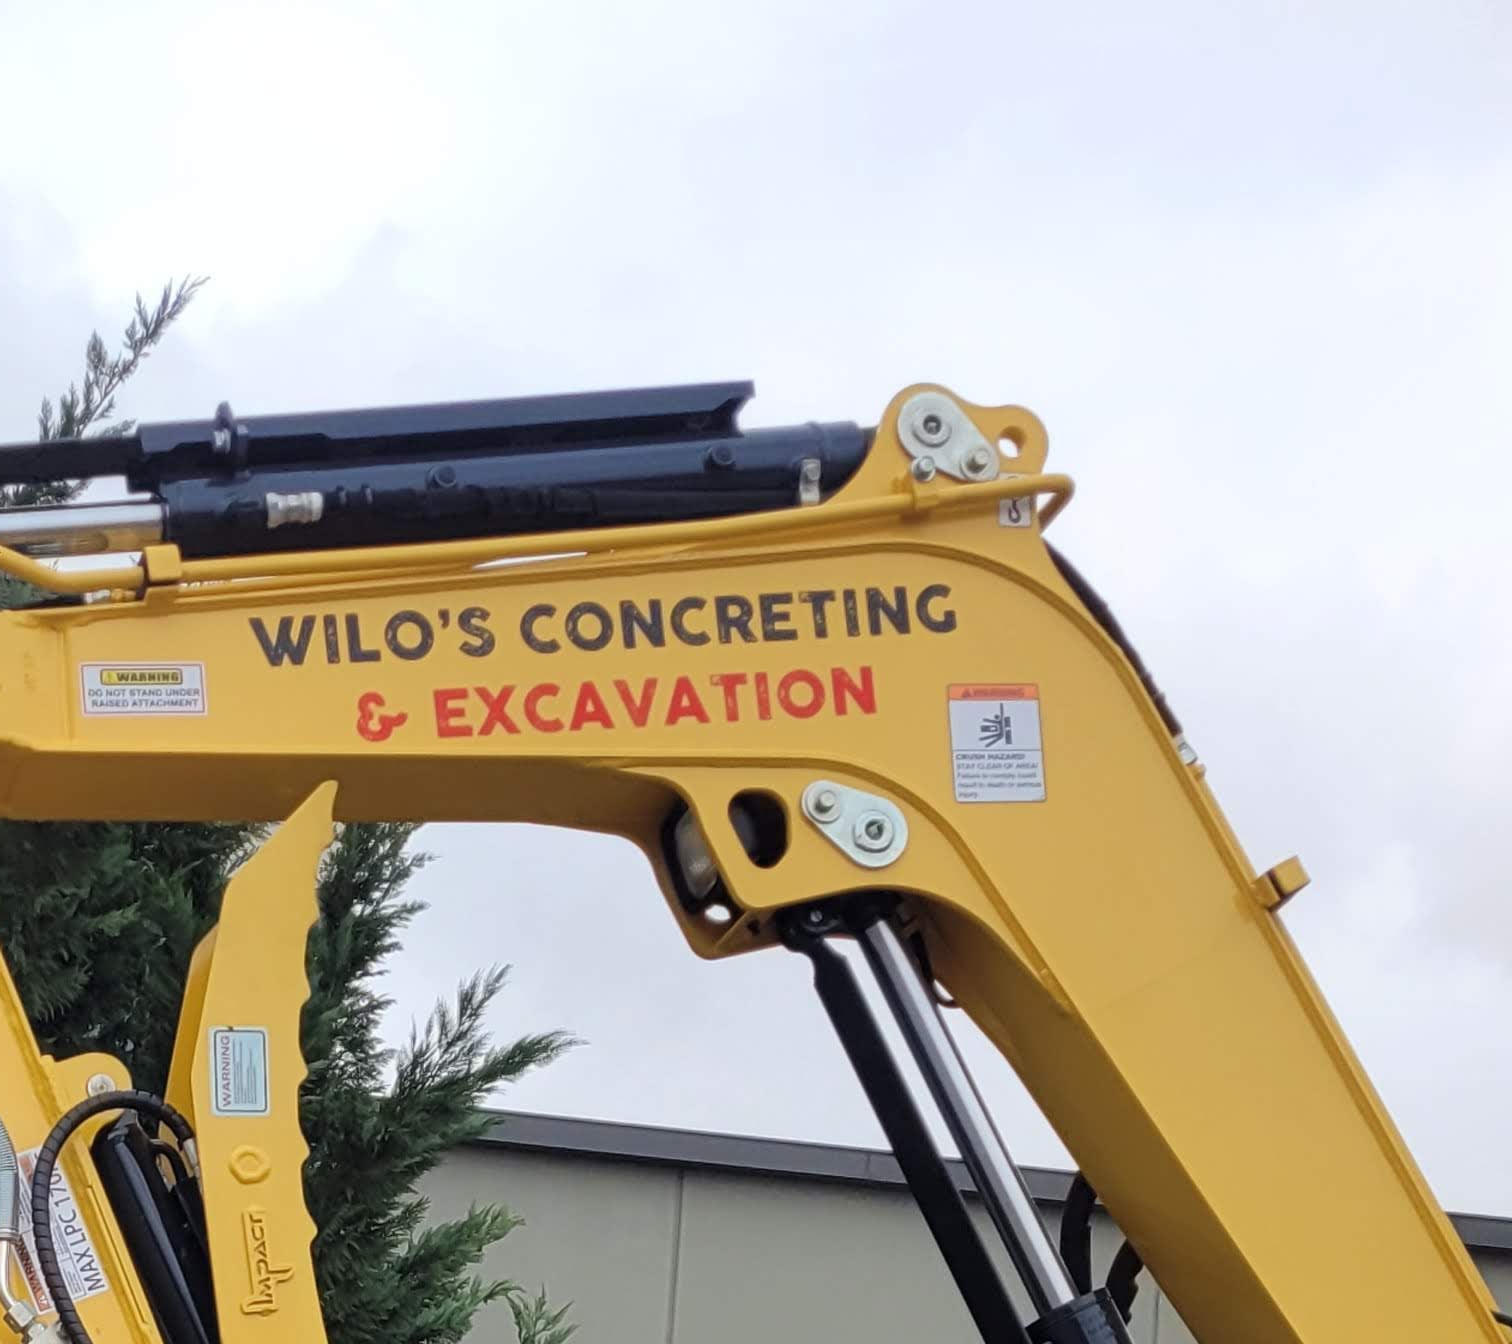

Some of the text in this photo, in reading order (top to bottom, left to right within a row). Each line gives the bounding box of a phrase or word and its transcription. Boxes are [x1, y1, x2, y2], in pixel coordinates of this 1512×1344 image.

[249, 584, 957, 666] WILO'S CONCRETING
[88, 688, 200, 697] DO NOT STAND UNDER
[117, 672, 179, 682] WARNING
[91, 699, 199, 708] RAISED ATTACHMENT
[357, 666, 877, 742] & EXCAVATION
[221, 1035, 231, 1107] WARNING
[58, 1209, 89, 1248] LPC
[73, 1247, 105, 1291] MAX
